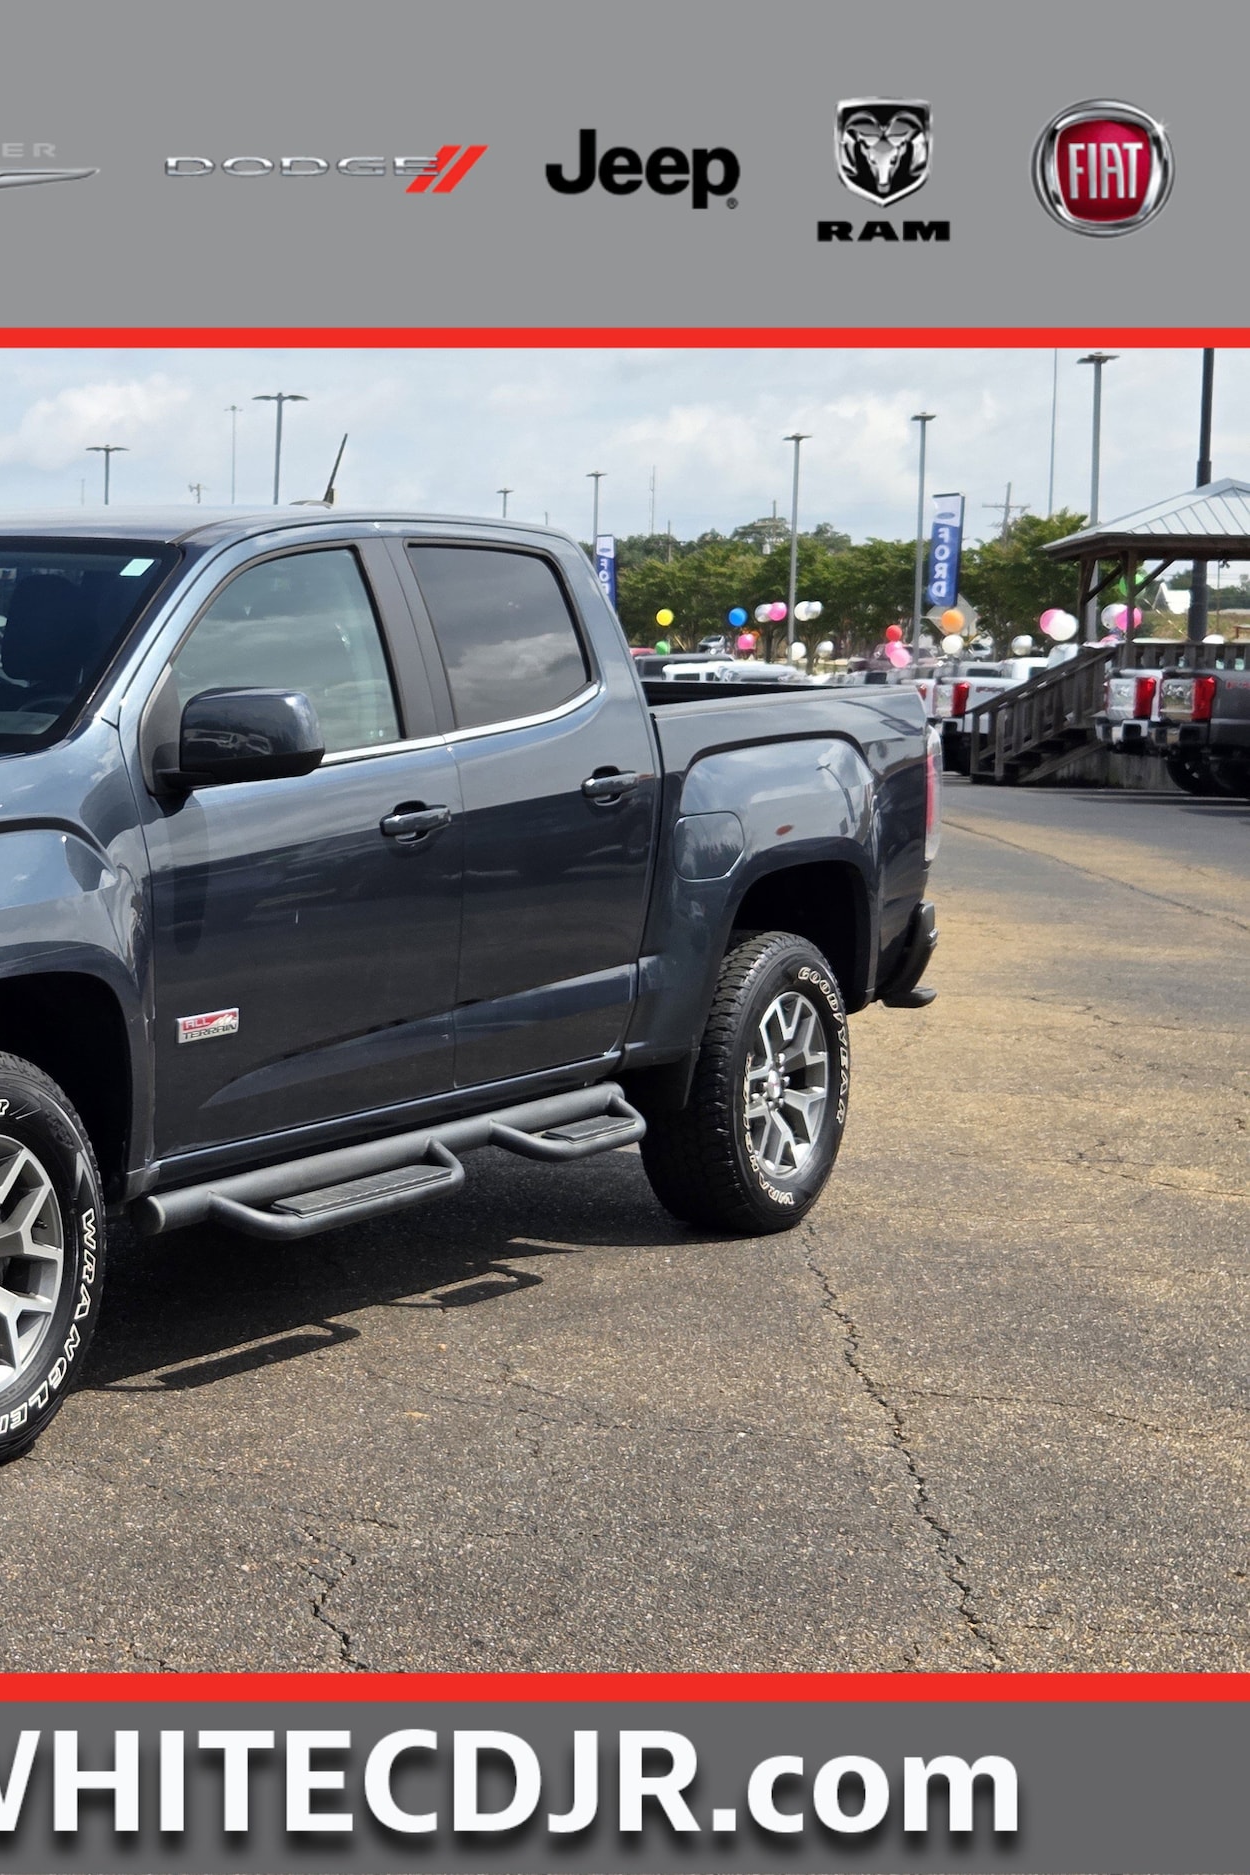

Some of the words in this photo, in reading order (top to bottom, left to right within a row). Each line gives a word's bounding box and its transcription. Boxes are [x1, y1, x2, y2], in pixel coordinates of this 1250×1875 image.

[183, 1023, 237, 1040] TERRAIN
[184, 1017, 211, 1029] ALL
[798, 966, 849, 1125] GOODYEAR
